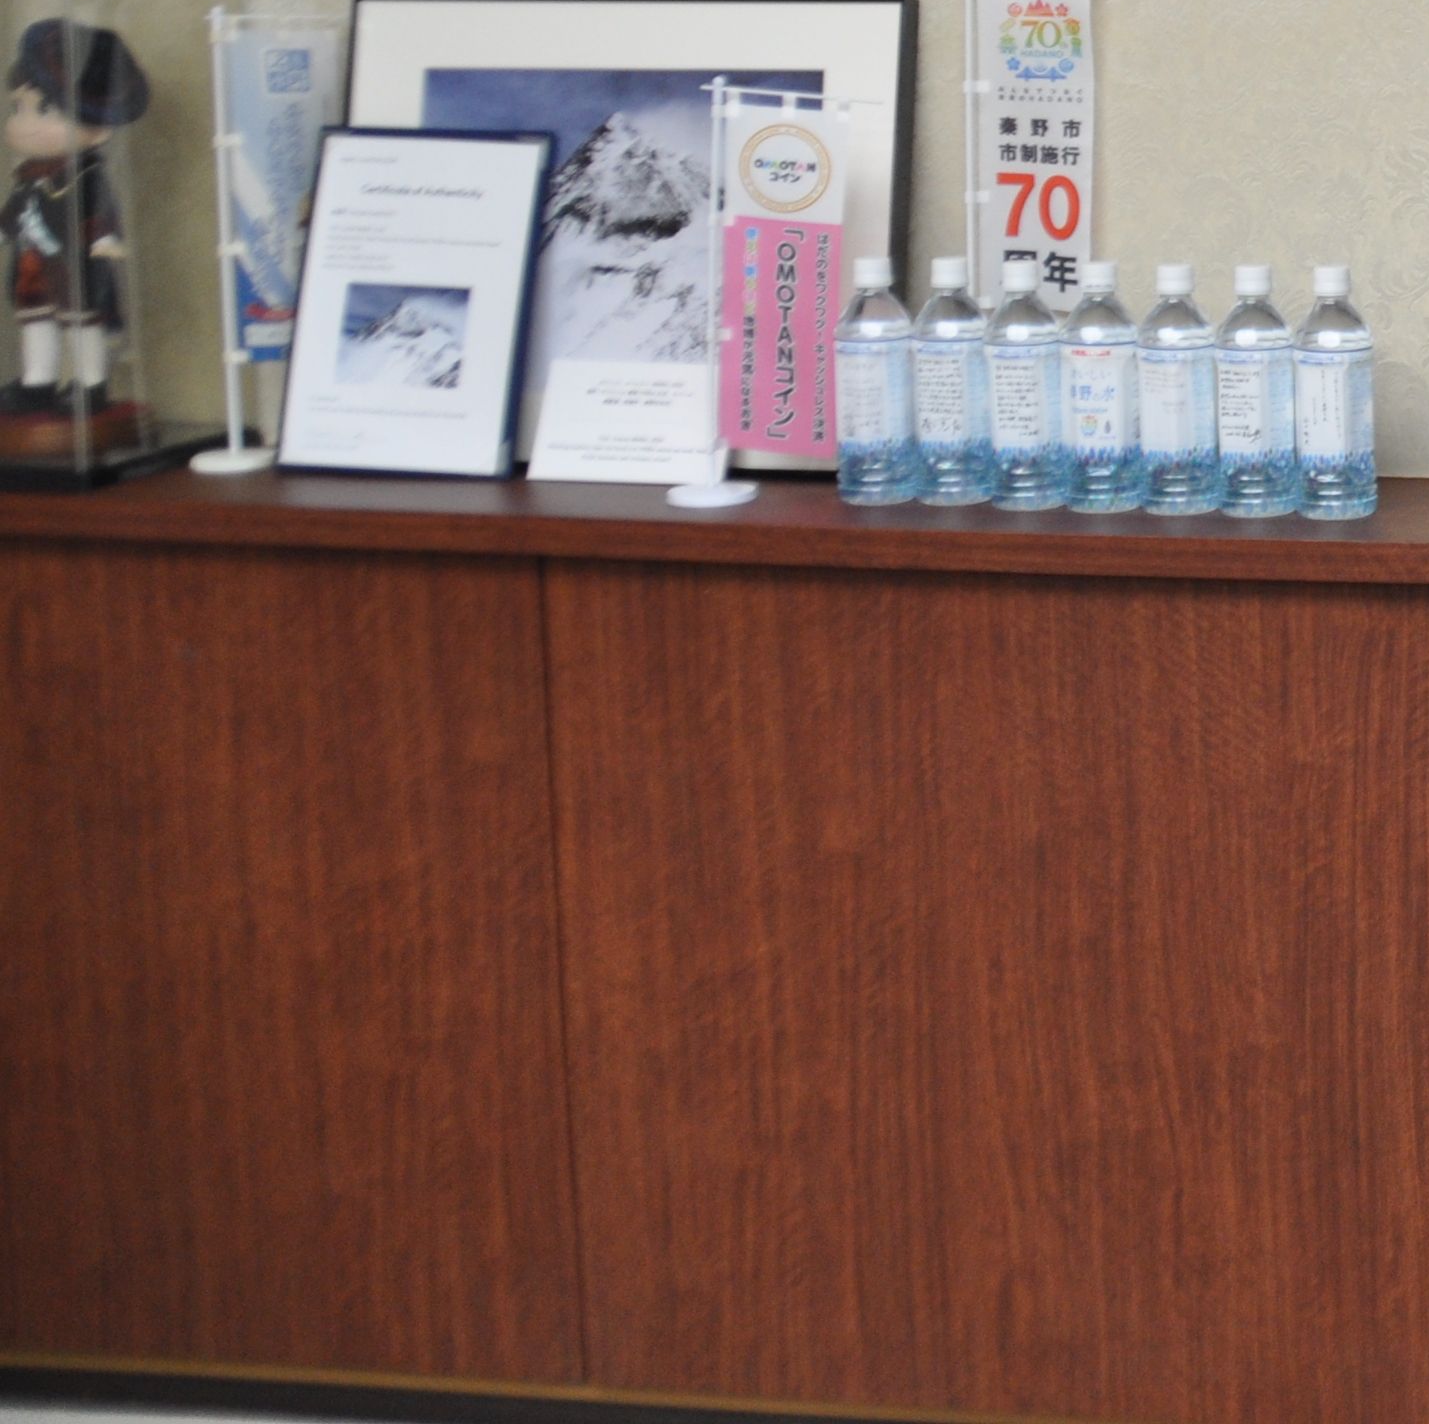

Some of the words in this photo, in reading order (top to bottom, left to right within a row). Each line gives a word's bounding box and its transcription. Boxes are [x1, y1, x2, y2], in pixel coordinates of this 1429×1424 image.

[998, 116, 1081, 139] 秦野市
[998, 143, 1080, 166] 市制施行
[769, 173, 802, 183] コイン
[996, 172, 1080, 241] 70
[1003, 250, 1078, 293] 年
